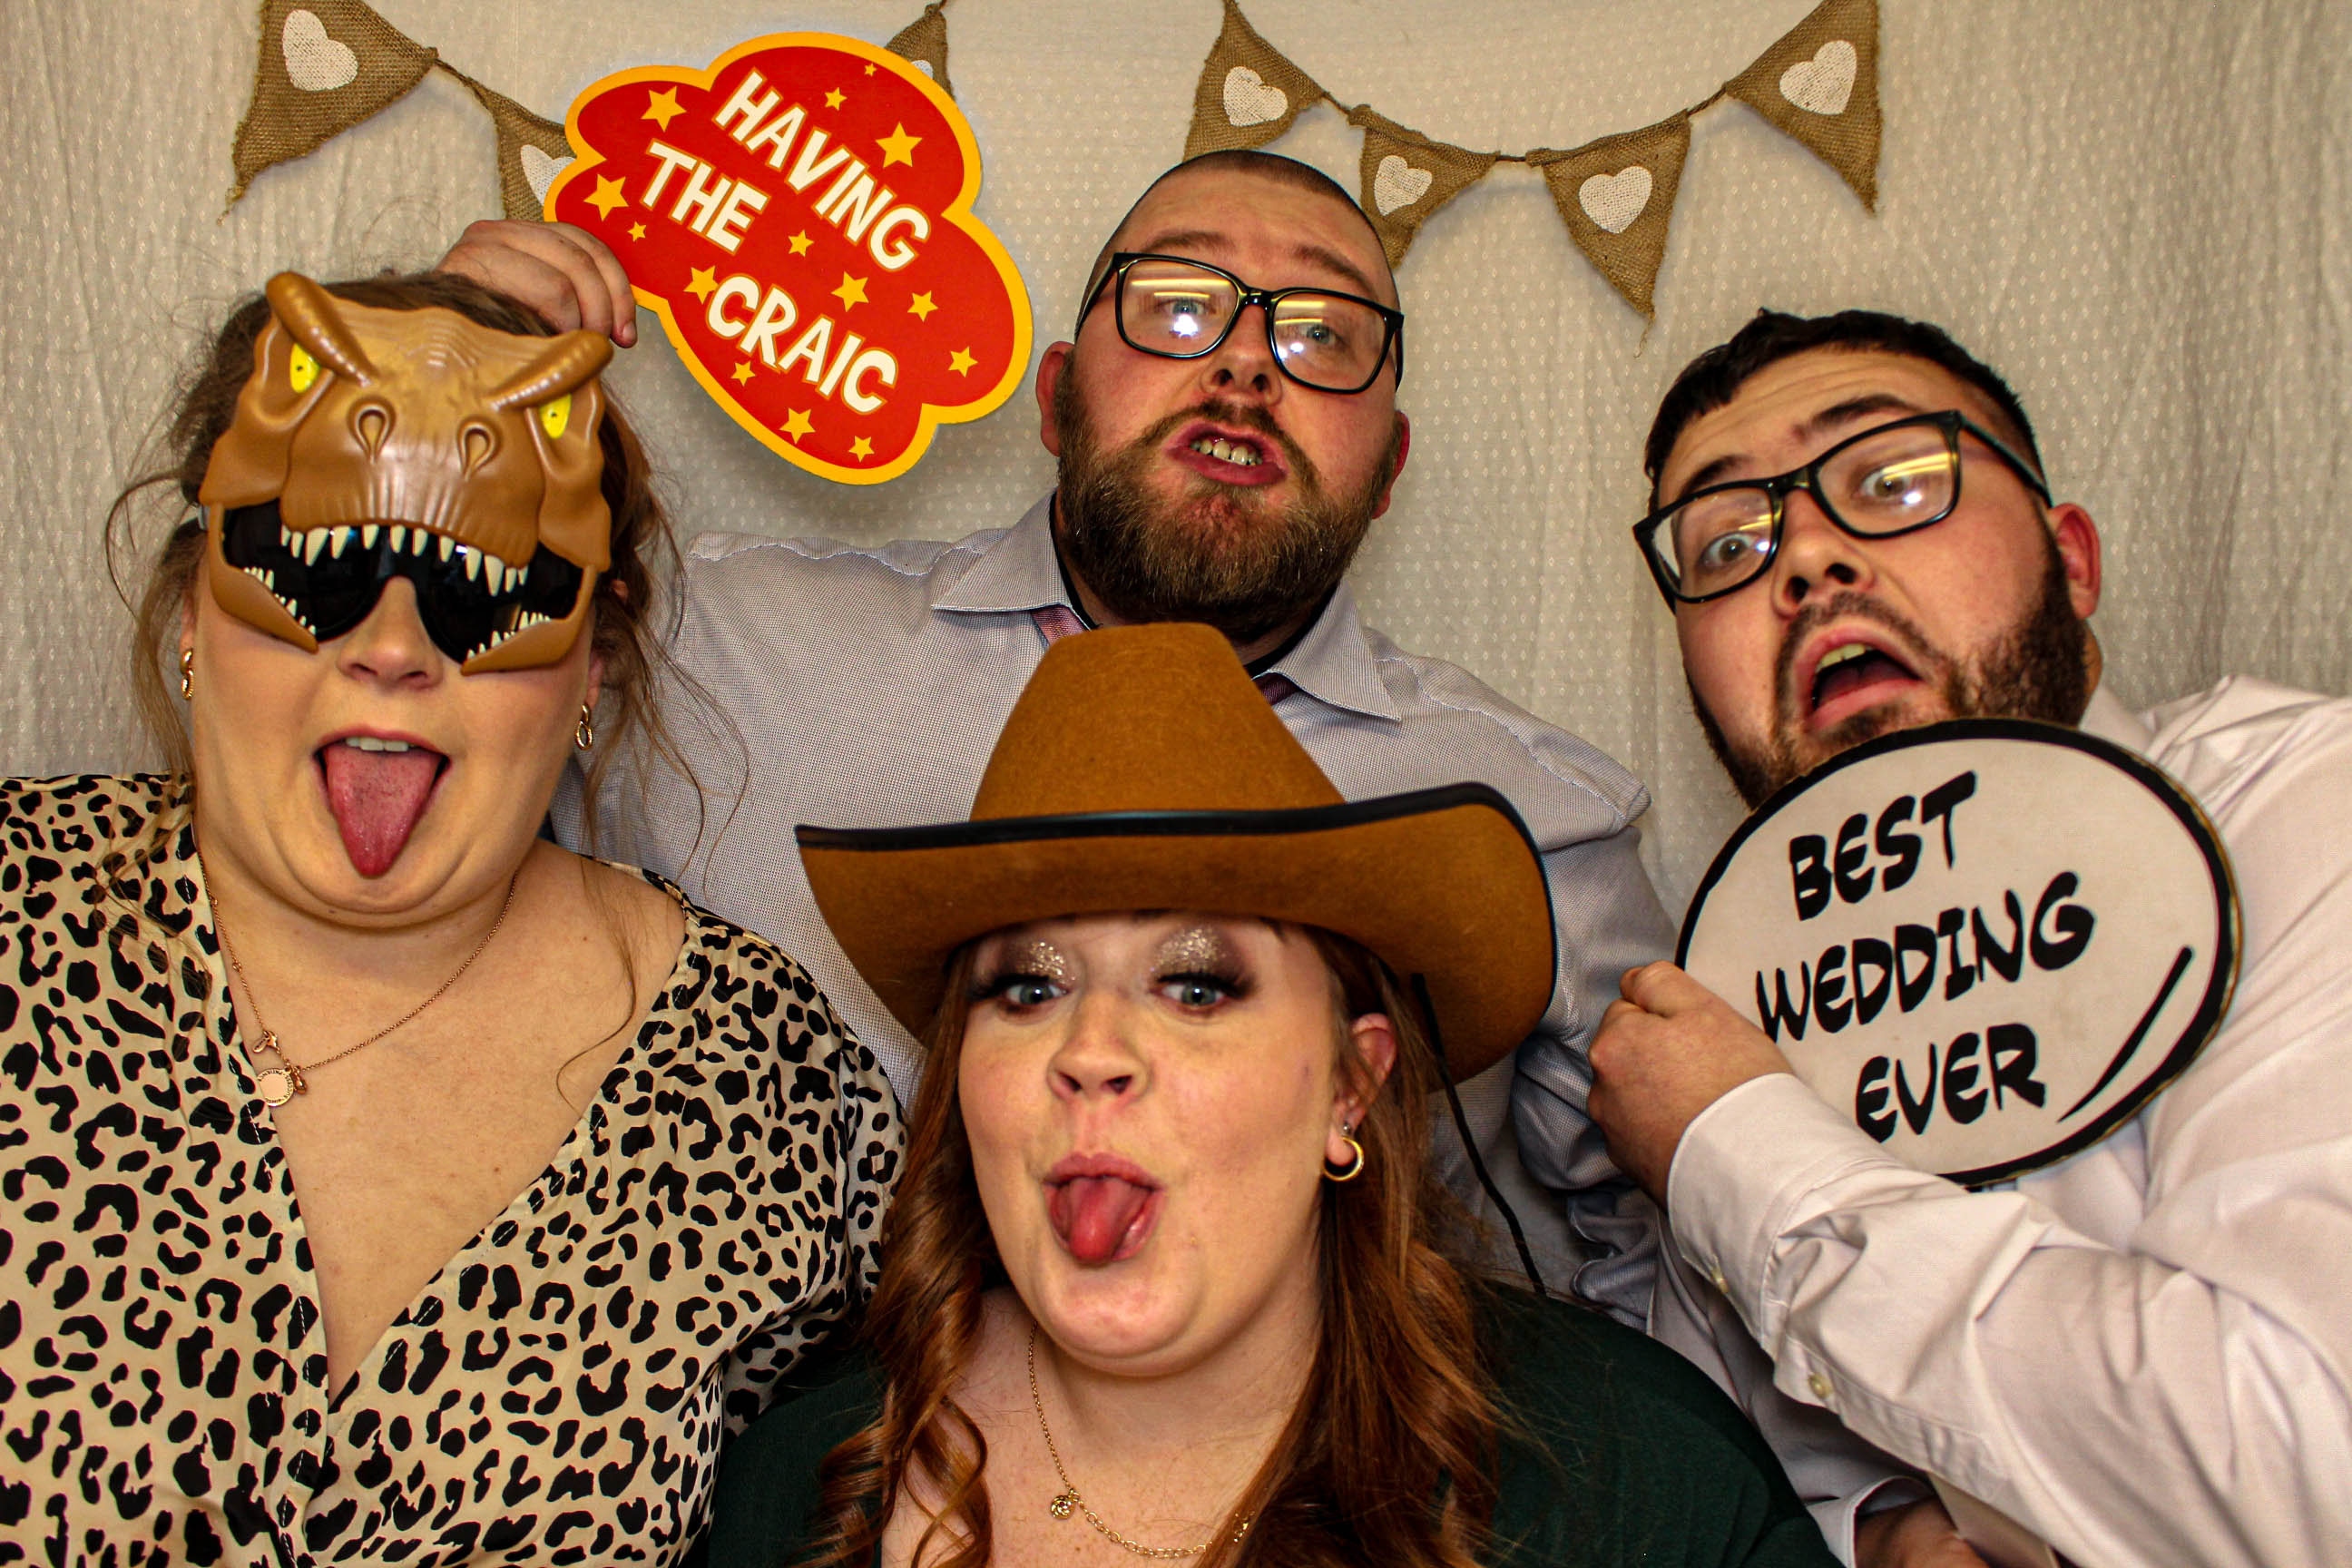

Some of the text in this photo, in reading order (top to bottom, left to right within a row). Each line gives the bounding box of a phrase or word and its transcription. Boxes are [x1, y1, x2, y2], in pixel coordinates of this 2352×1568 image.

[639, 141, 769, 254] THE
[712, 71, 932, 270] HAVING
[706, 275, 898, 414] CRAIC
[1788, 769, 1978, 921] BEST
[1756, 870, 2095, 1043] WEDDING
[1856, 1022, 2046, 1143] EVER
